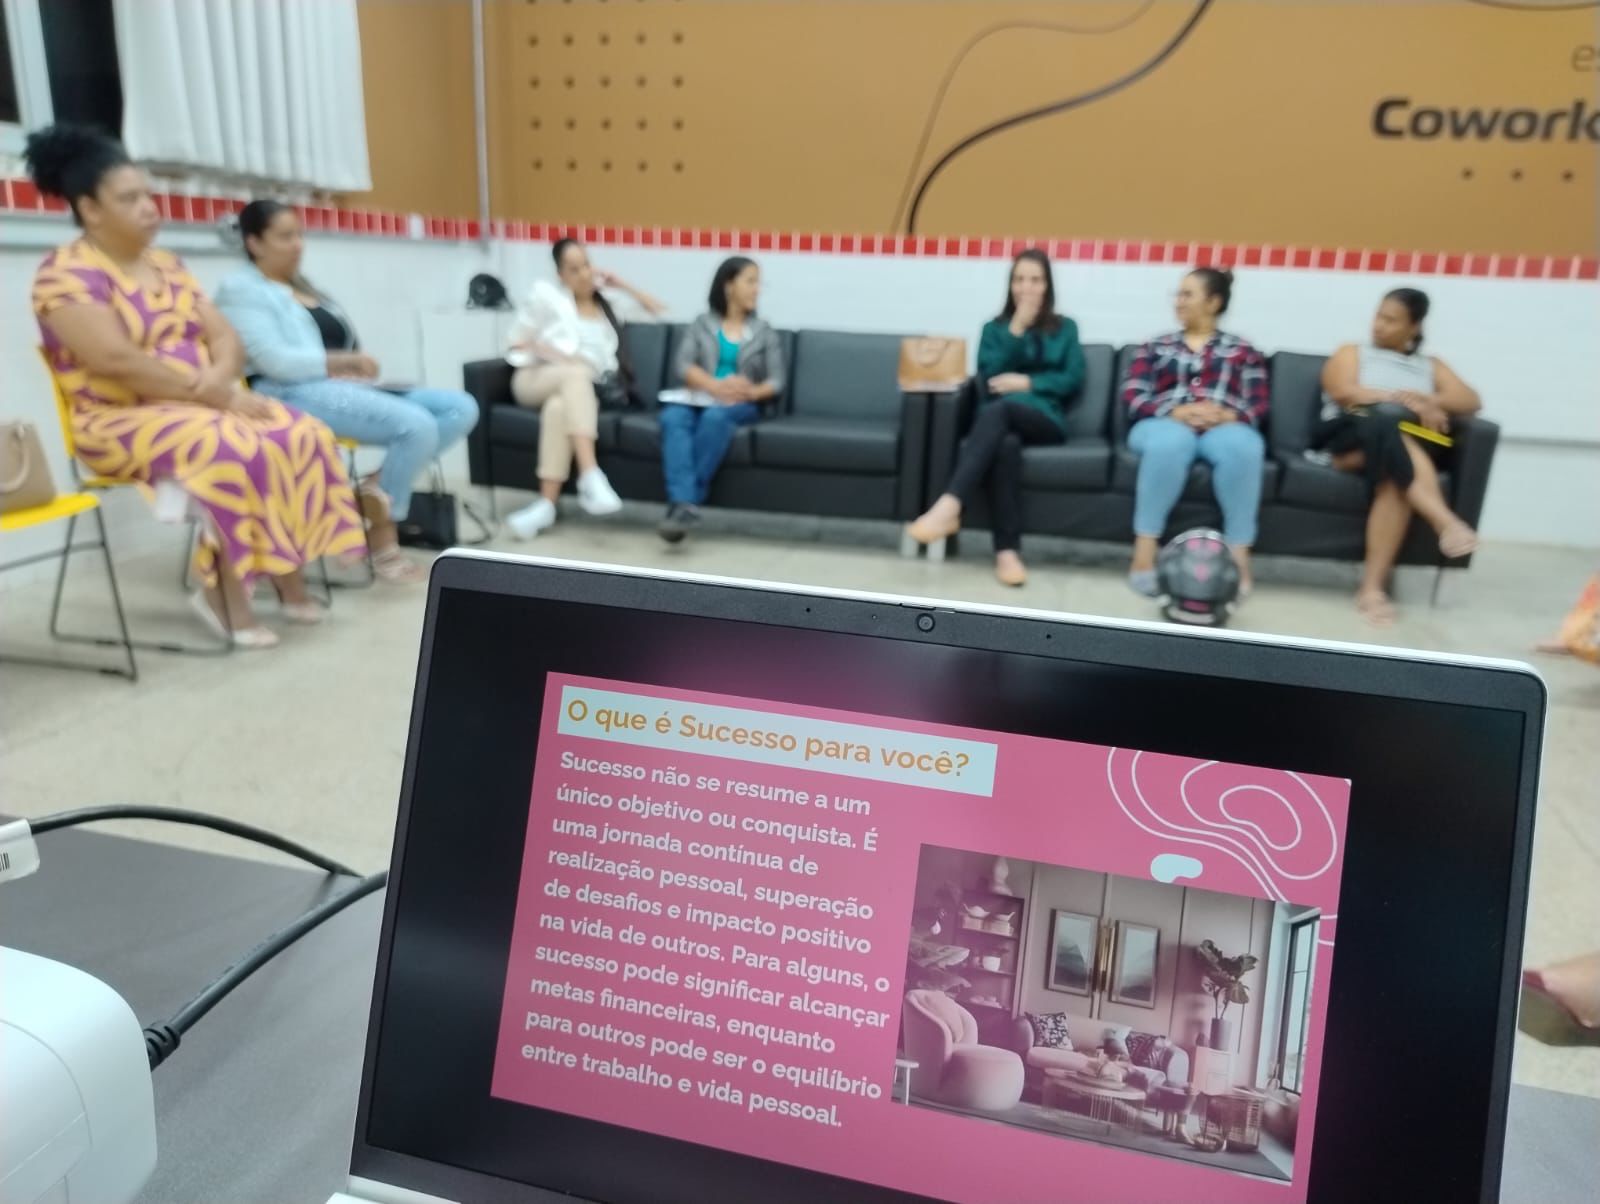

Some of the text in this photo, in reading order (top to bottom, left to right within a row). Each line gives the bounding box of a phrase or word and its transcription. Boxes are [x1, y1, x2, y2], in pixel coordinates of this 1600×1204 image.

[567, 699, 970, 777] O que é Sucesso para você?
[556, 782, 879, 852] único objetivo ou conquista. É
[560, 751, 871, 816] Sucesso não se resume a um
[548, 850, 874, 920] realização pessoal, superação
[552, 818, 819, 876] uma jornada contínua de
[539, 913, 890, 993] na vida de outros. Para alguns, o
[543, 878, 872, 954] de desafios e impacto positivo
[530, 978, 836, 1053] metas financeiras, enquanto
[535, 946, 890, 1028] sucesso pode significar alcançar
[521, 1044, 842, 1127] entre trabalho e vida pessoal.
[525, 1011, 882, 1099] para outros pode ser o equilíbrio
